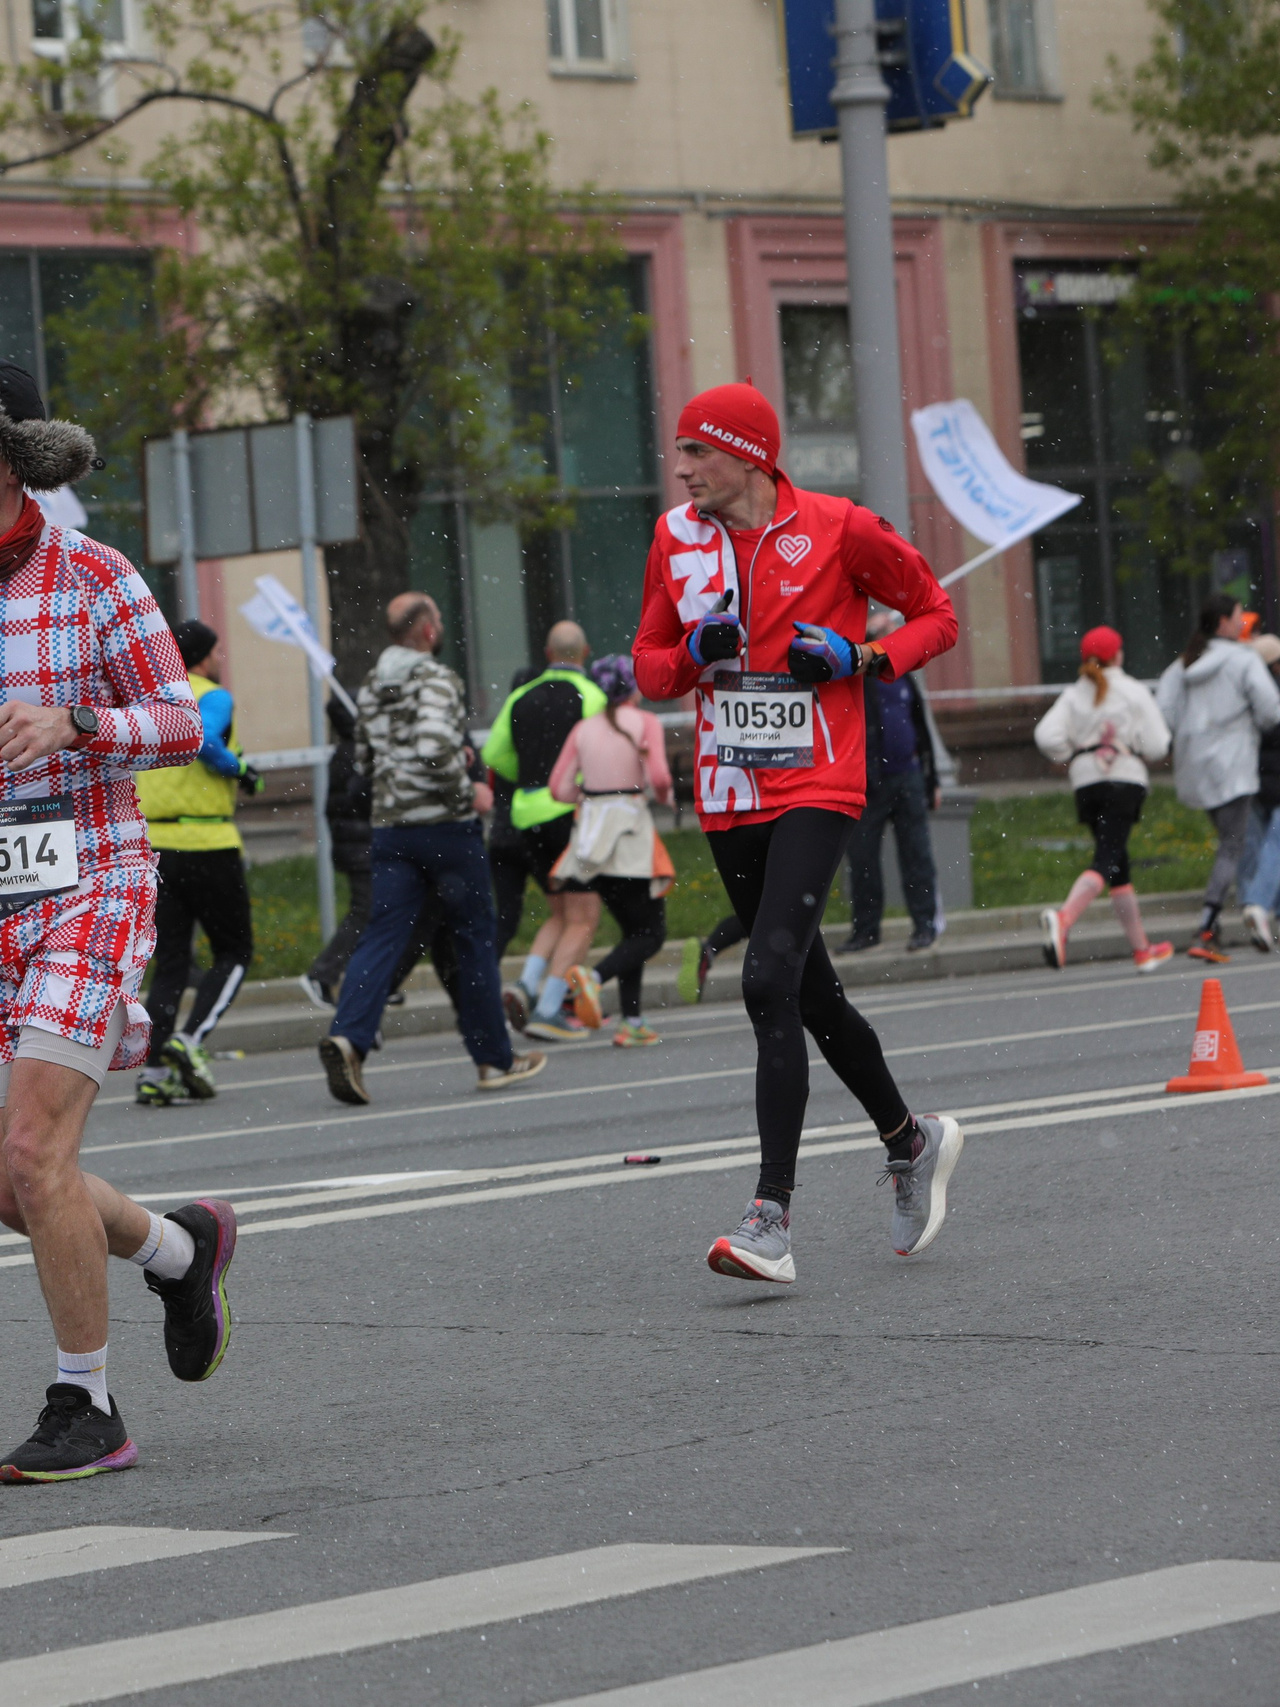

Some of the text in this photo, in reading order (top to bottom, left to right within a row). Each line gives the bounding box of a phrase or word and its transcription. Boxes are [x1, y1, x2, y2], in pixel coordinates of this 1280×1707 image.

[699, 421, 768, 461] MADSHUS
[720, 700, 806, 729] 10530
[739, 731, 781, 741] ДМИТРИЙ
[723, 746, 734, 763] D
[32, 811, 62, 820] 2025
